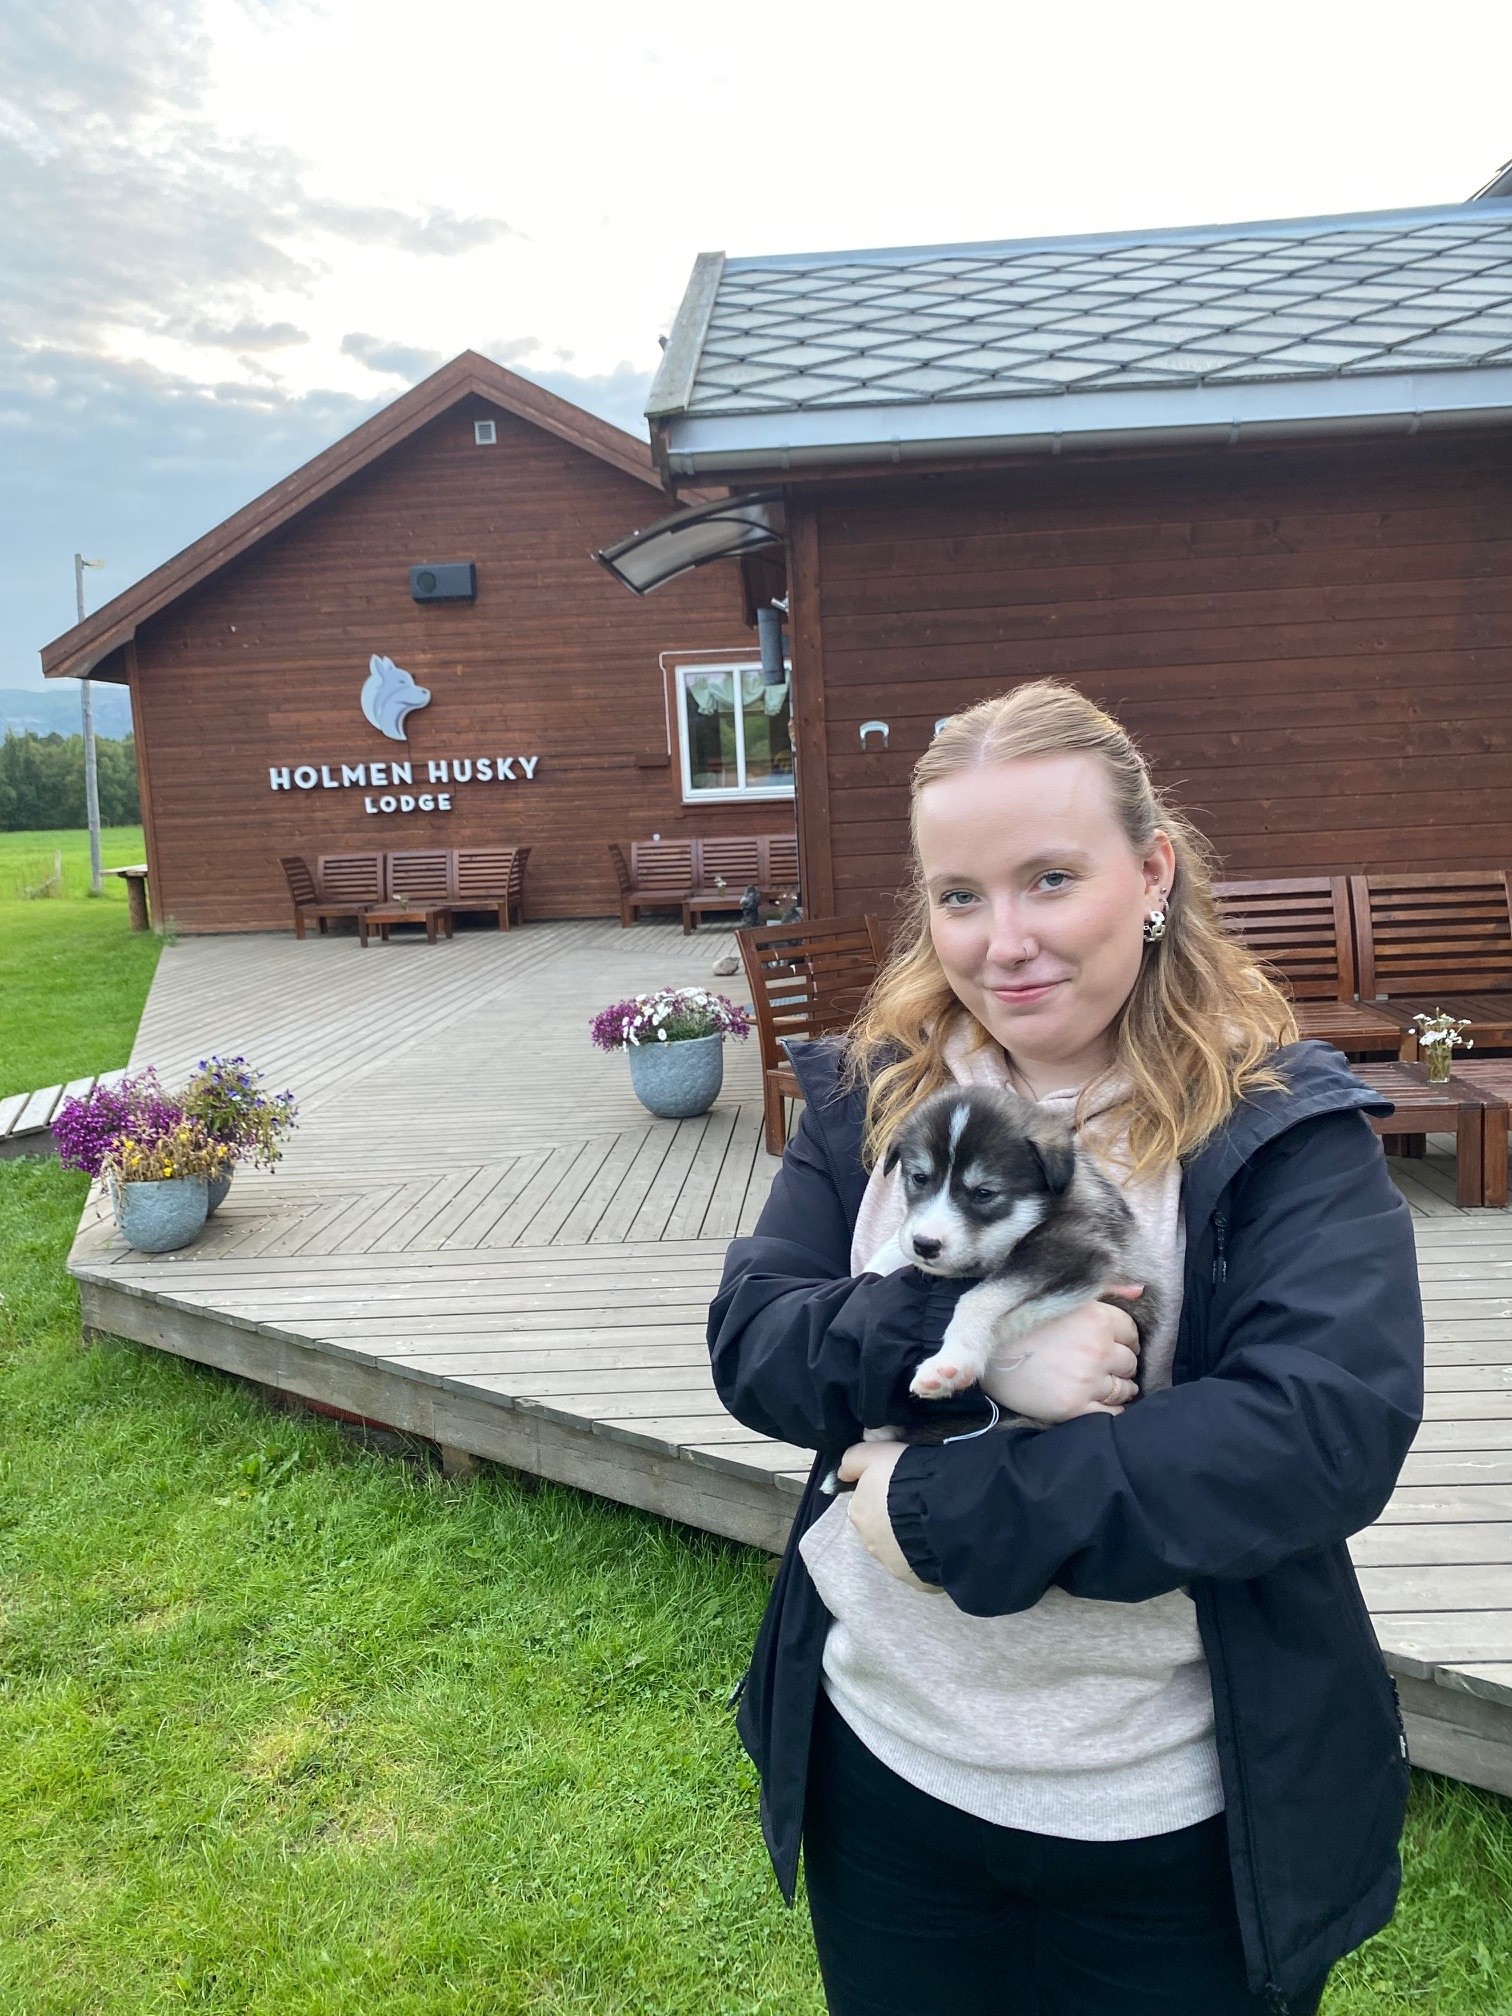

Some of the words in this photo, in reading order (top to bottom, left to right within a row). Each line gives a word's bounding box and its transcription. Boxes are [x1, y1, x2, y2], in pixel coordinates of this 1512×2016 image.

[269, 761, 413, 791] HOLMEN
[427, 756, 539, 784] HUSKY
[364, 793, 452, 814] LODGE
